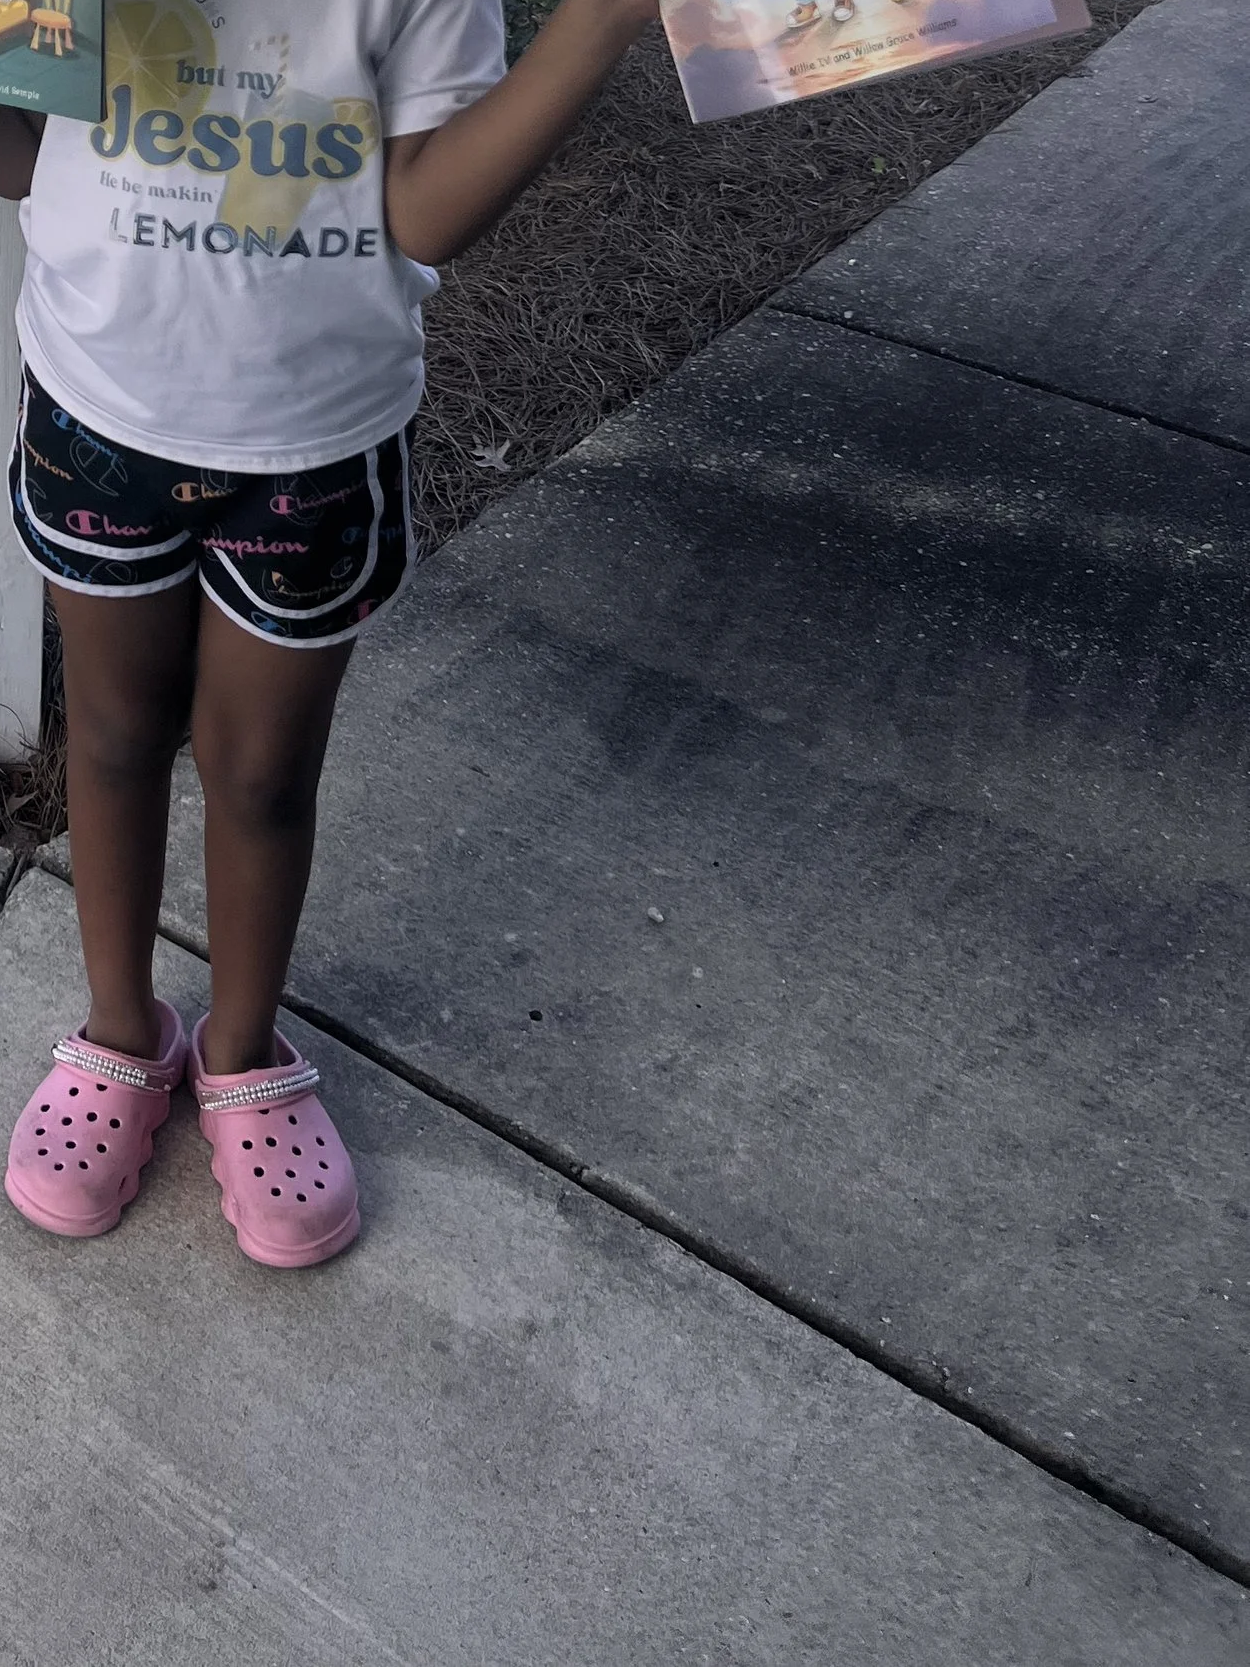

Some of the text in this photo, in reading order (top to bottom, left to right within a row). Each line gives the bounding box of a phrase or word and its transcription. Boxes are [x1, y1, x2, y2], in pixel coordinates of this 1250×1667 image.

[787, 61, 816, 77] Willie
[833, 51, 851, 64] and
[851, 41, 884, 57] Willow
[886, 32, 915, 48] Grace
[915, 18, 958, 37] Williams
[11, 86, 40, 100] Semple
[176, 59, 283, 100] but my
[89, 84, 364, 180] Jesus
[99, 170, 219, 204] He be makin'
[108, 206, 379, 258] LEMONADE
